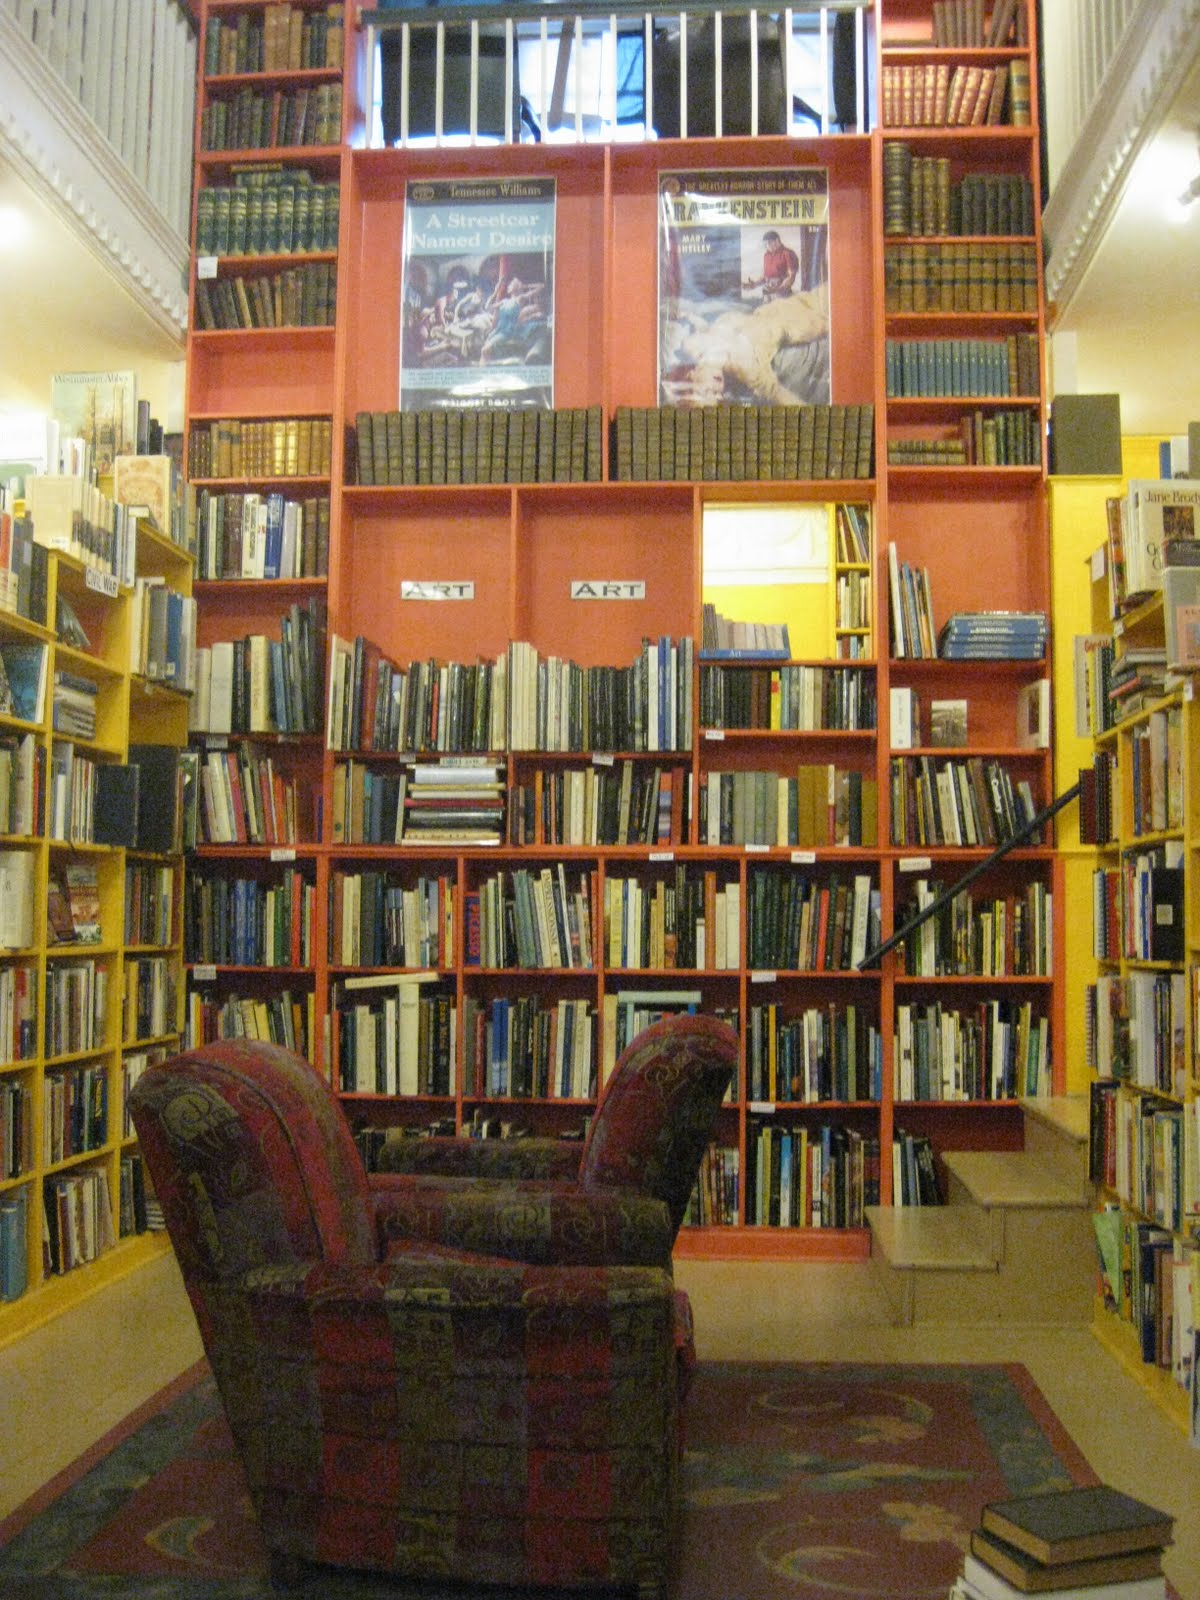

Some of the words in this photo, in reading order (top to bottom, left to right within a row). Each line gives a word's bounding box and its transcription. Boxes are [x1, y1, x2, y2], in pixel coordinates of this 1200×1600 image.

[450, 185, 497, 198] Tennessee
[500, 184, 542, 196] Williams
[426, 213, 442, 229] A
[447, 212, 540, 229] Streetcar
[412, 232, 481, 249] Named
[490, 231, 553, 248] Desire
[682, 234, 706, 243] MARY
[678, 244, 711, 254] SHELLEY
[1145, 490, 1171, 503] Jane
[87, 569, 103, 590] CIVIL
[103, 575, 117, 592] WAR
[405, 583, 470, 597] ART
[575, 583, 642, 597] ART
